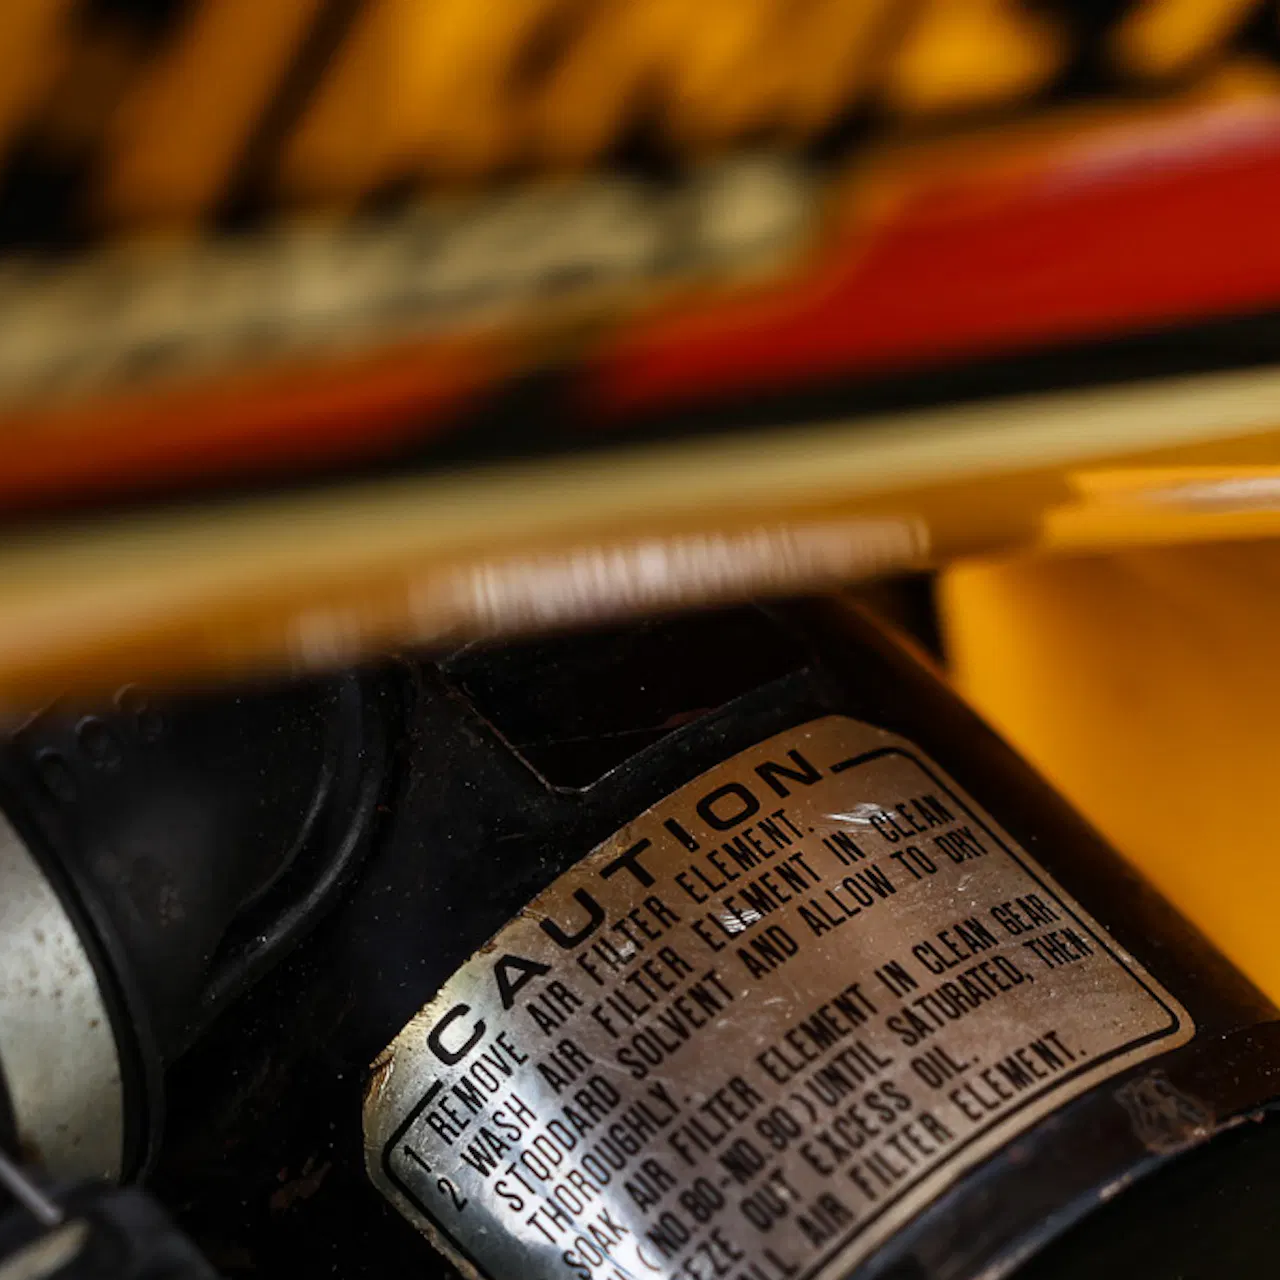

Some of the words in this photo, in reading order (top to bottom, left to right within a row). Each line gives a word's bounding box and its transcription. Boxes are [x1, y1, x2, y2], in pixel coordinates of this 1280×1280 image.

[404, 1144, 431, 1173] 1
[425, 1031, 529, 1145] REMOVE
[526, 980, 584, 1036] AIR
[576, 895, 681, 986] FILTER
[675, 808, 815, 904] ELEMENT.
[427, 749, 823, 1066] CAUTION
[437, 1177, 468, 1212] 2
[460, 1093, 537, 1178] WASH
[536, 1038, 594, 1096] AIR
[591, 946, 695, 1039] FILTER
[690, 852, 821, 952] ELEMENT
[822, 830, 866, 865] IN
[869, 794, 955, 844] CLEAN
[494, 1074, 621, 1212] STODDARD
[616, 968, 734, 1080] SOLVENT
[735, 924, 799, 980] AND
[797, 863, 896, 936] ALLOW
[889, 845, 938, 880] TO
[933, 825, 988, 864] DRY
[624, 1158, 677, 1214] AIR
[667, 1076, 765, 1167] FILTER
[756, 982, 878, 1084] ELEMENT
[874, 959, 920, 998] IN
[911, 916, 1000, 975] CLEAN
[990, 893, 1060, 936] GEAR
[884, 955, 1034, 1047] SATURATED,
[1022, 927, 1094, 969] THEN
[526, 1080, 692, 1244] THOROUGHLY.
[739, 1166, 801, 1233] OUT
[799, 1079, 912, 1176] EXCESS
[910, 1044, 981, 1090] OIL.
[796, 1190, 855, 1248] AIR
[848, 1110, 955, 1201] FILTER
[948, 1029, 1087, 1122] ELEMENT.
